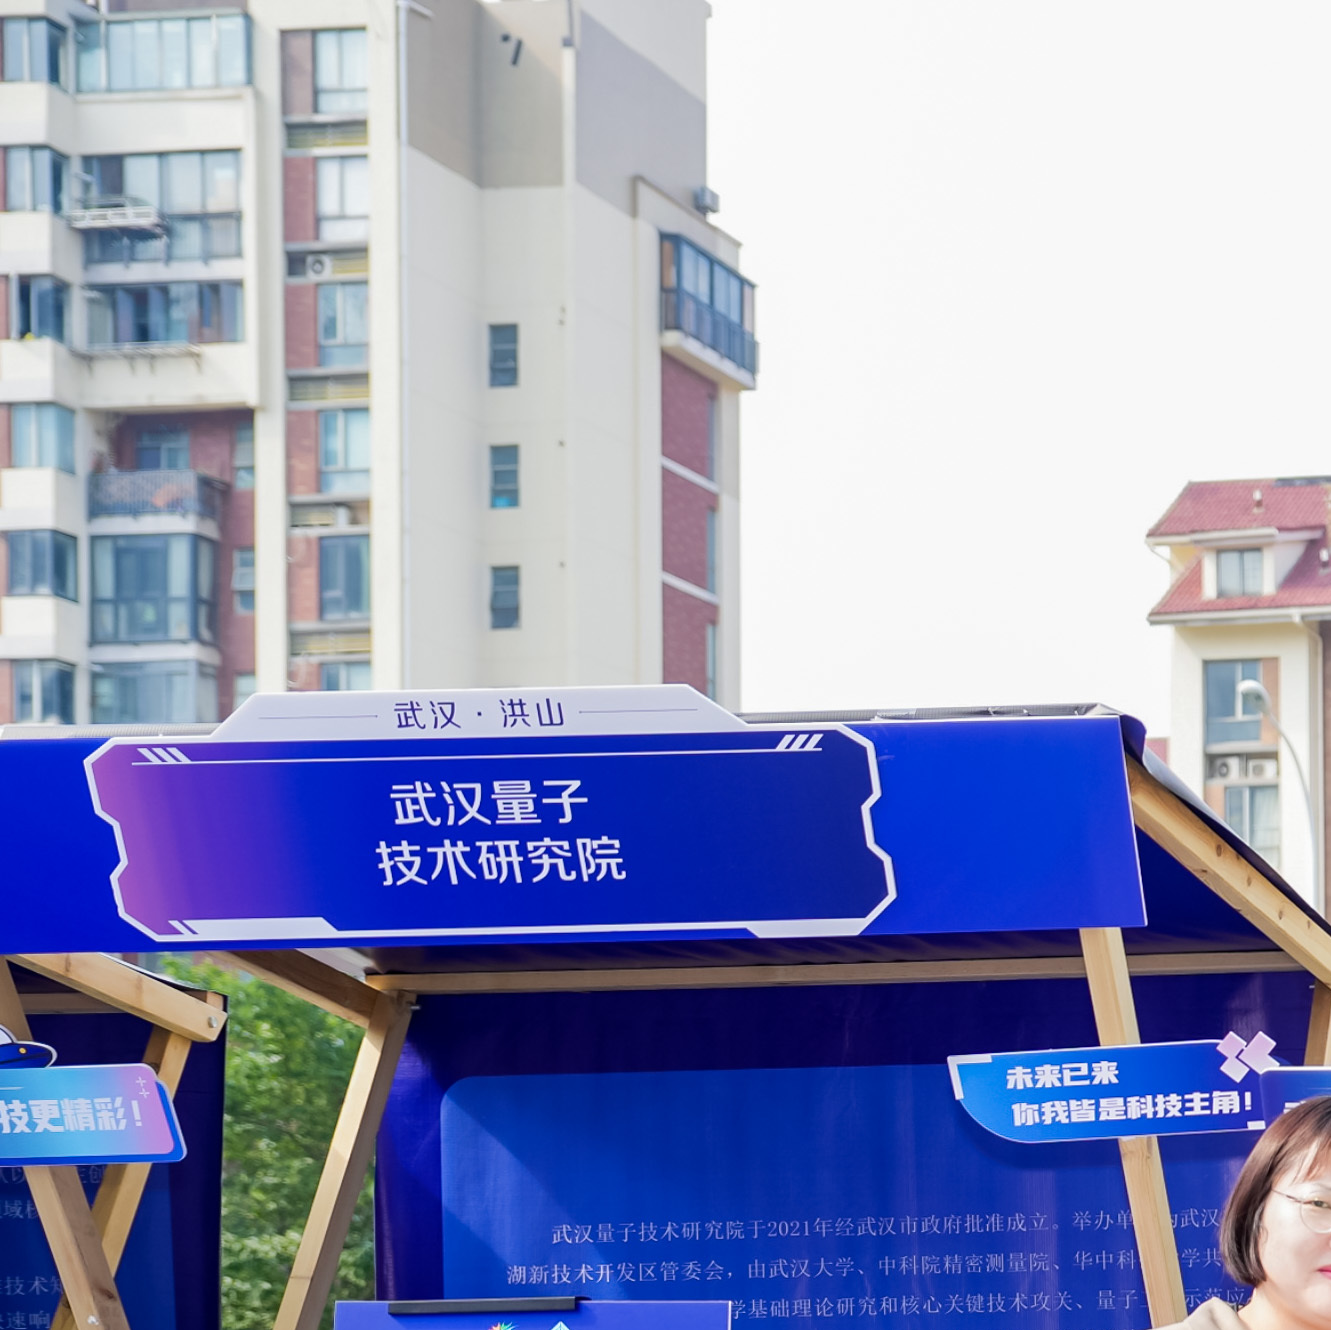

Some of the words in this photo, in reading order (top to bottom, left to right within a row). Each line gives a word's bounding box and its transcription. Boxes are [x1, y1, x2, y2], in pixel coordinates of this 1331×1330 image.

[388, 778, 589, 827] 武汉量子
[376, 834, 629, 888] 技术研究院
[1005, 1060, 1121, 1091] 未来已来
[1011, 1090, 1254, 1127] 你我皆是科技主角！
